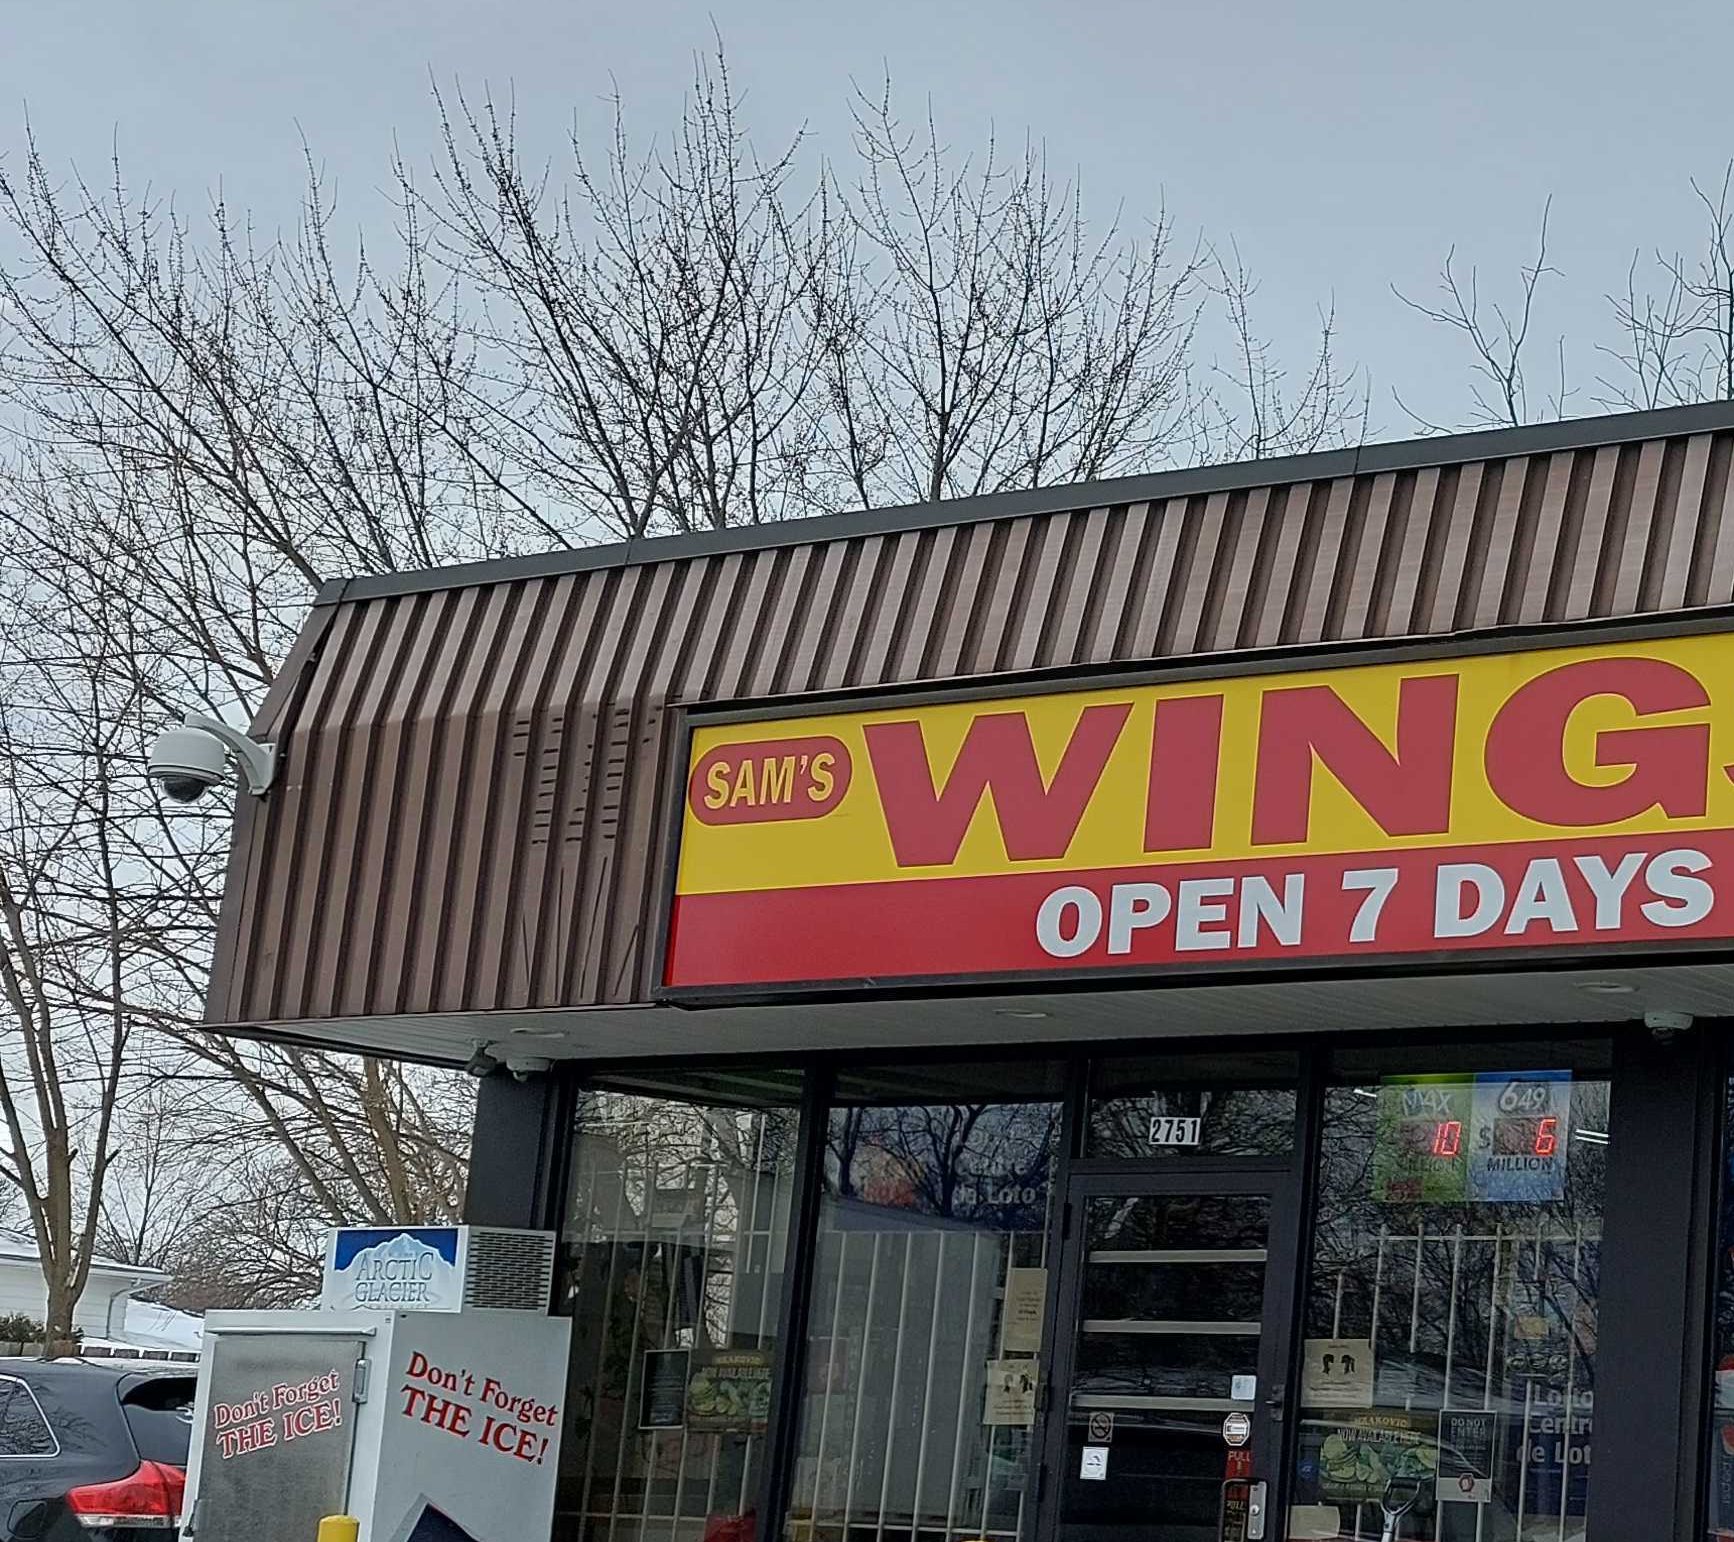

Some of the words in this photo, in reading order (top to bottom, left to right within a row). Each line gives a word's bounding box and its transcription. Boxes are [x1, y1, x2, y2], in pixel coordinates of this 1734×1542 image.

[703, 753, 836, 810] SAM'S
[1036, 873, 1305, 958] OPEN
[1342, 868, 1399, 943] 7
[1434, 849, 1715, 939] DAYS
[1499, 1082, 1547, 1111] 649
[1151, 1119, 1198, 1143] 2751
[1535, 1118, 1558, 1155] 6
[1487, 1157, 1554, 1172] MILLION
[355, 1252, 433, 1281] ARCTIC
[354, 1282, 430, 1303] GLACIER
[214, 1392, 269, 1428] Don't
[272, 1368, 341, 1409] Forget
[406, 1351, 475, 1396] Don't
[479, 1378, 558, 1427] Forget
[216, 1419, 277, 1459] THE
[283, 1398, 343, 1442] ICE!
[401, 1384, 473, 1438] THE
[478, 1416, 549, 1465] ICE!
[1555, 1441, 1592, 1465] Lot
